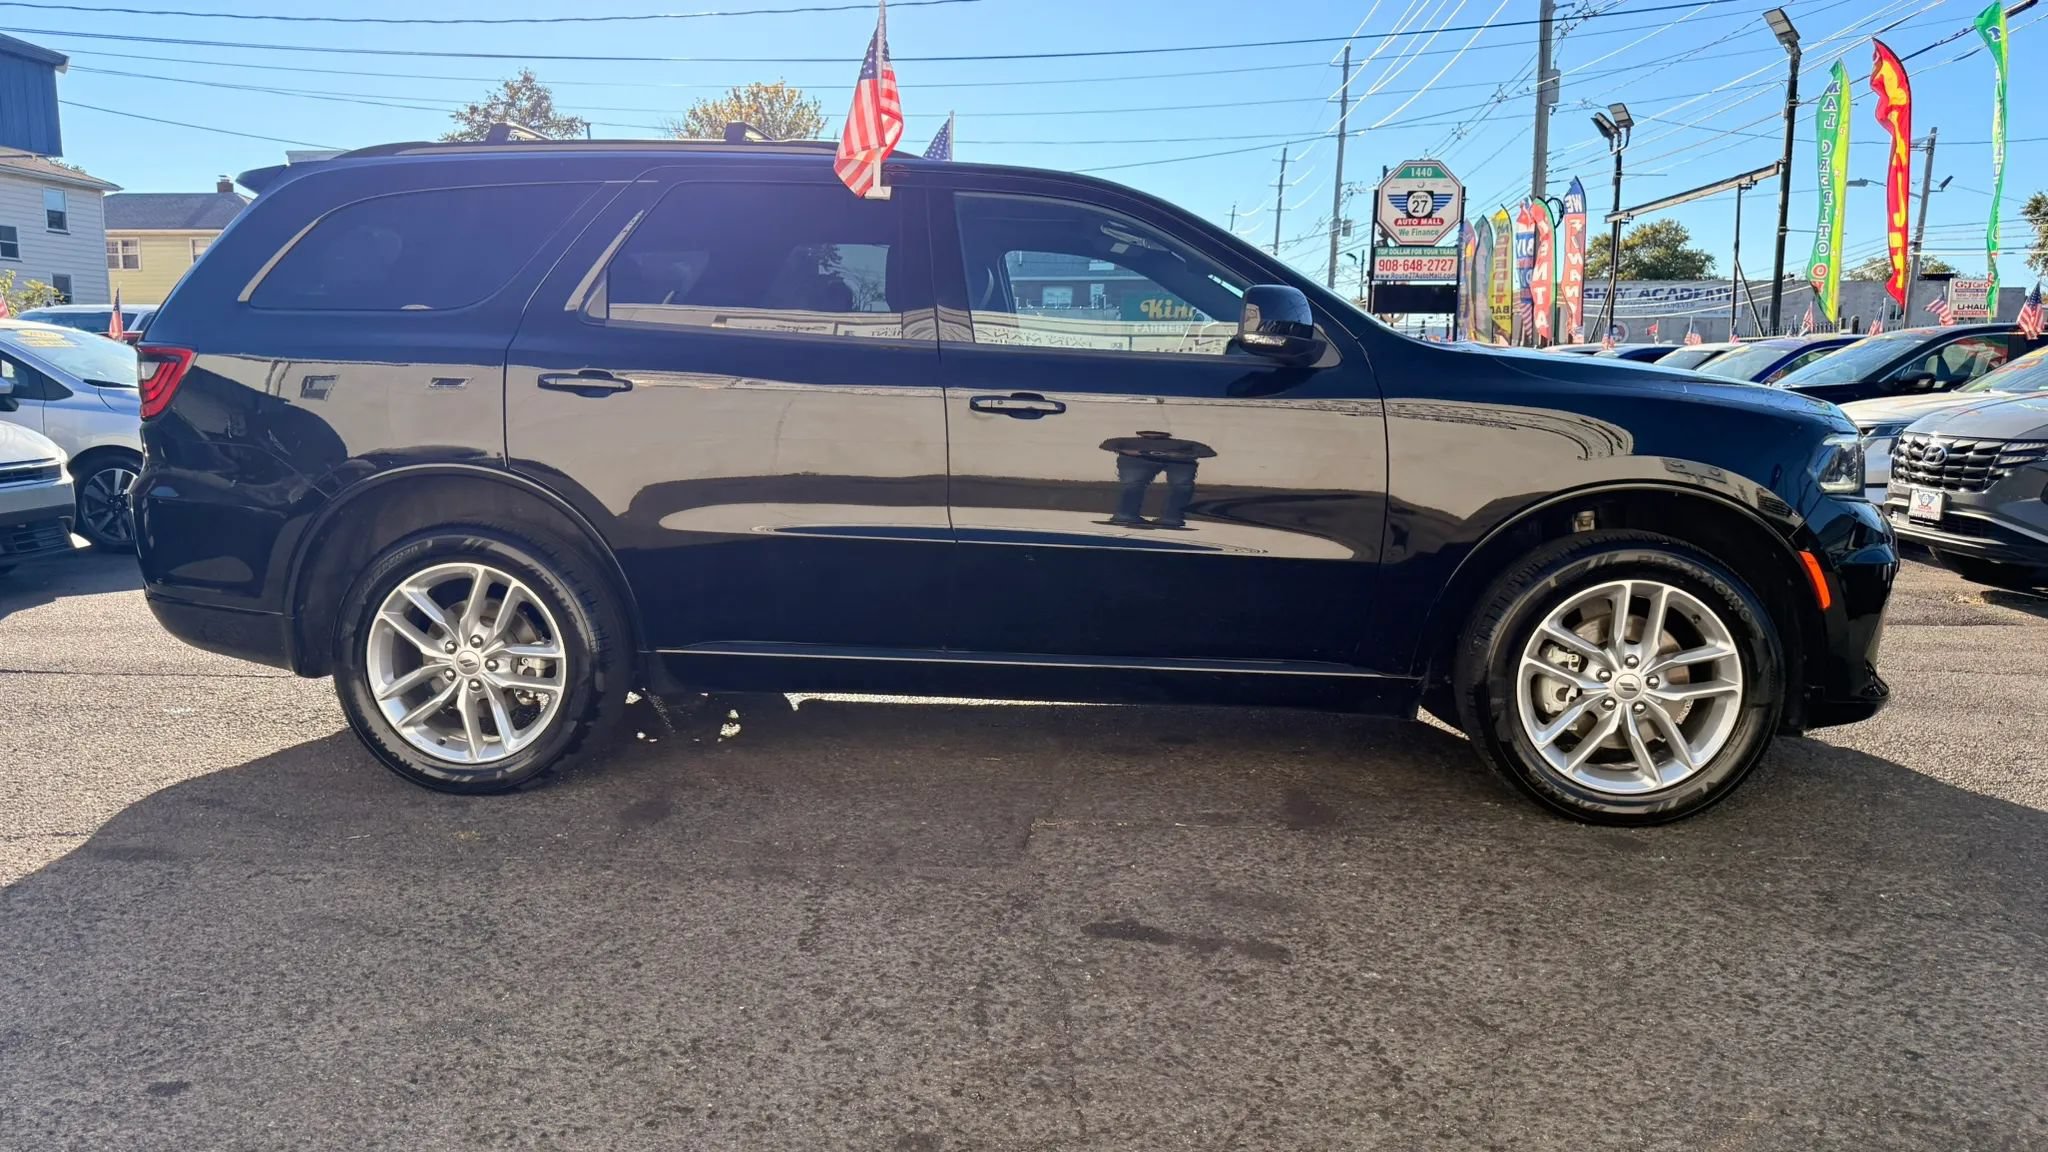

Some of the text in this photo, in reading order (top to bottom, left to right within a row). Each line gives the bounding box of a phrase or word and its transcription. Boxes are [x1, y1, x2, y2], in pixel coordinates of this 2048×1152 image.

[1410, 167, 1433, 177] 1440
[1411, 200, 1428, 213] 27
[1396, 218, 1442, 226] AUTO MALL
[1398, 228, 1440, 237] We Finance
[1378, 259, 1454, 271] 908-648-2727
